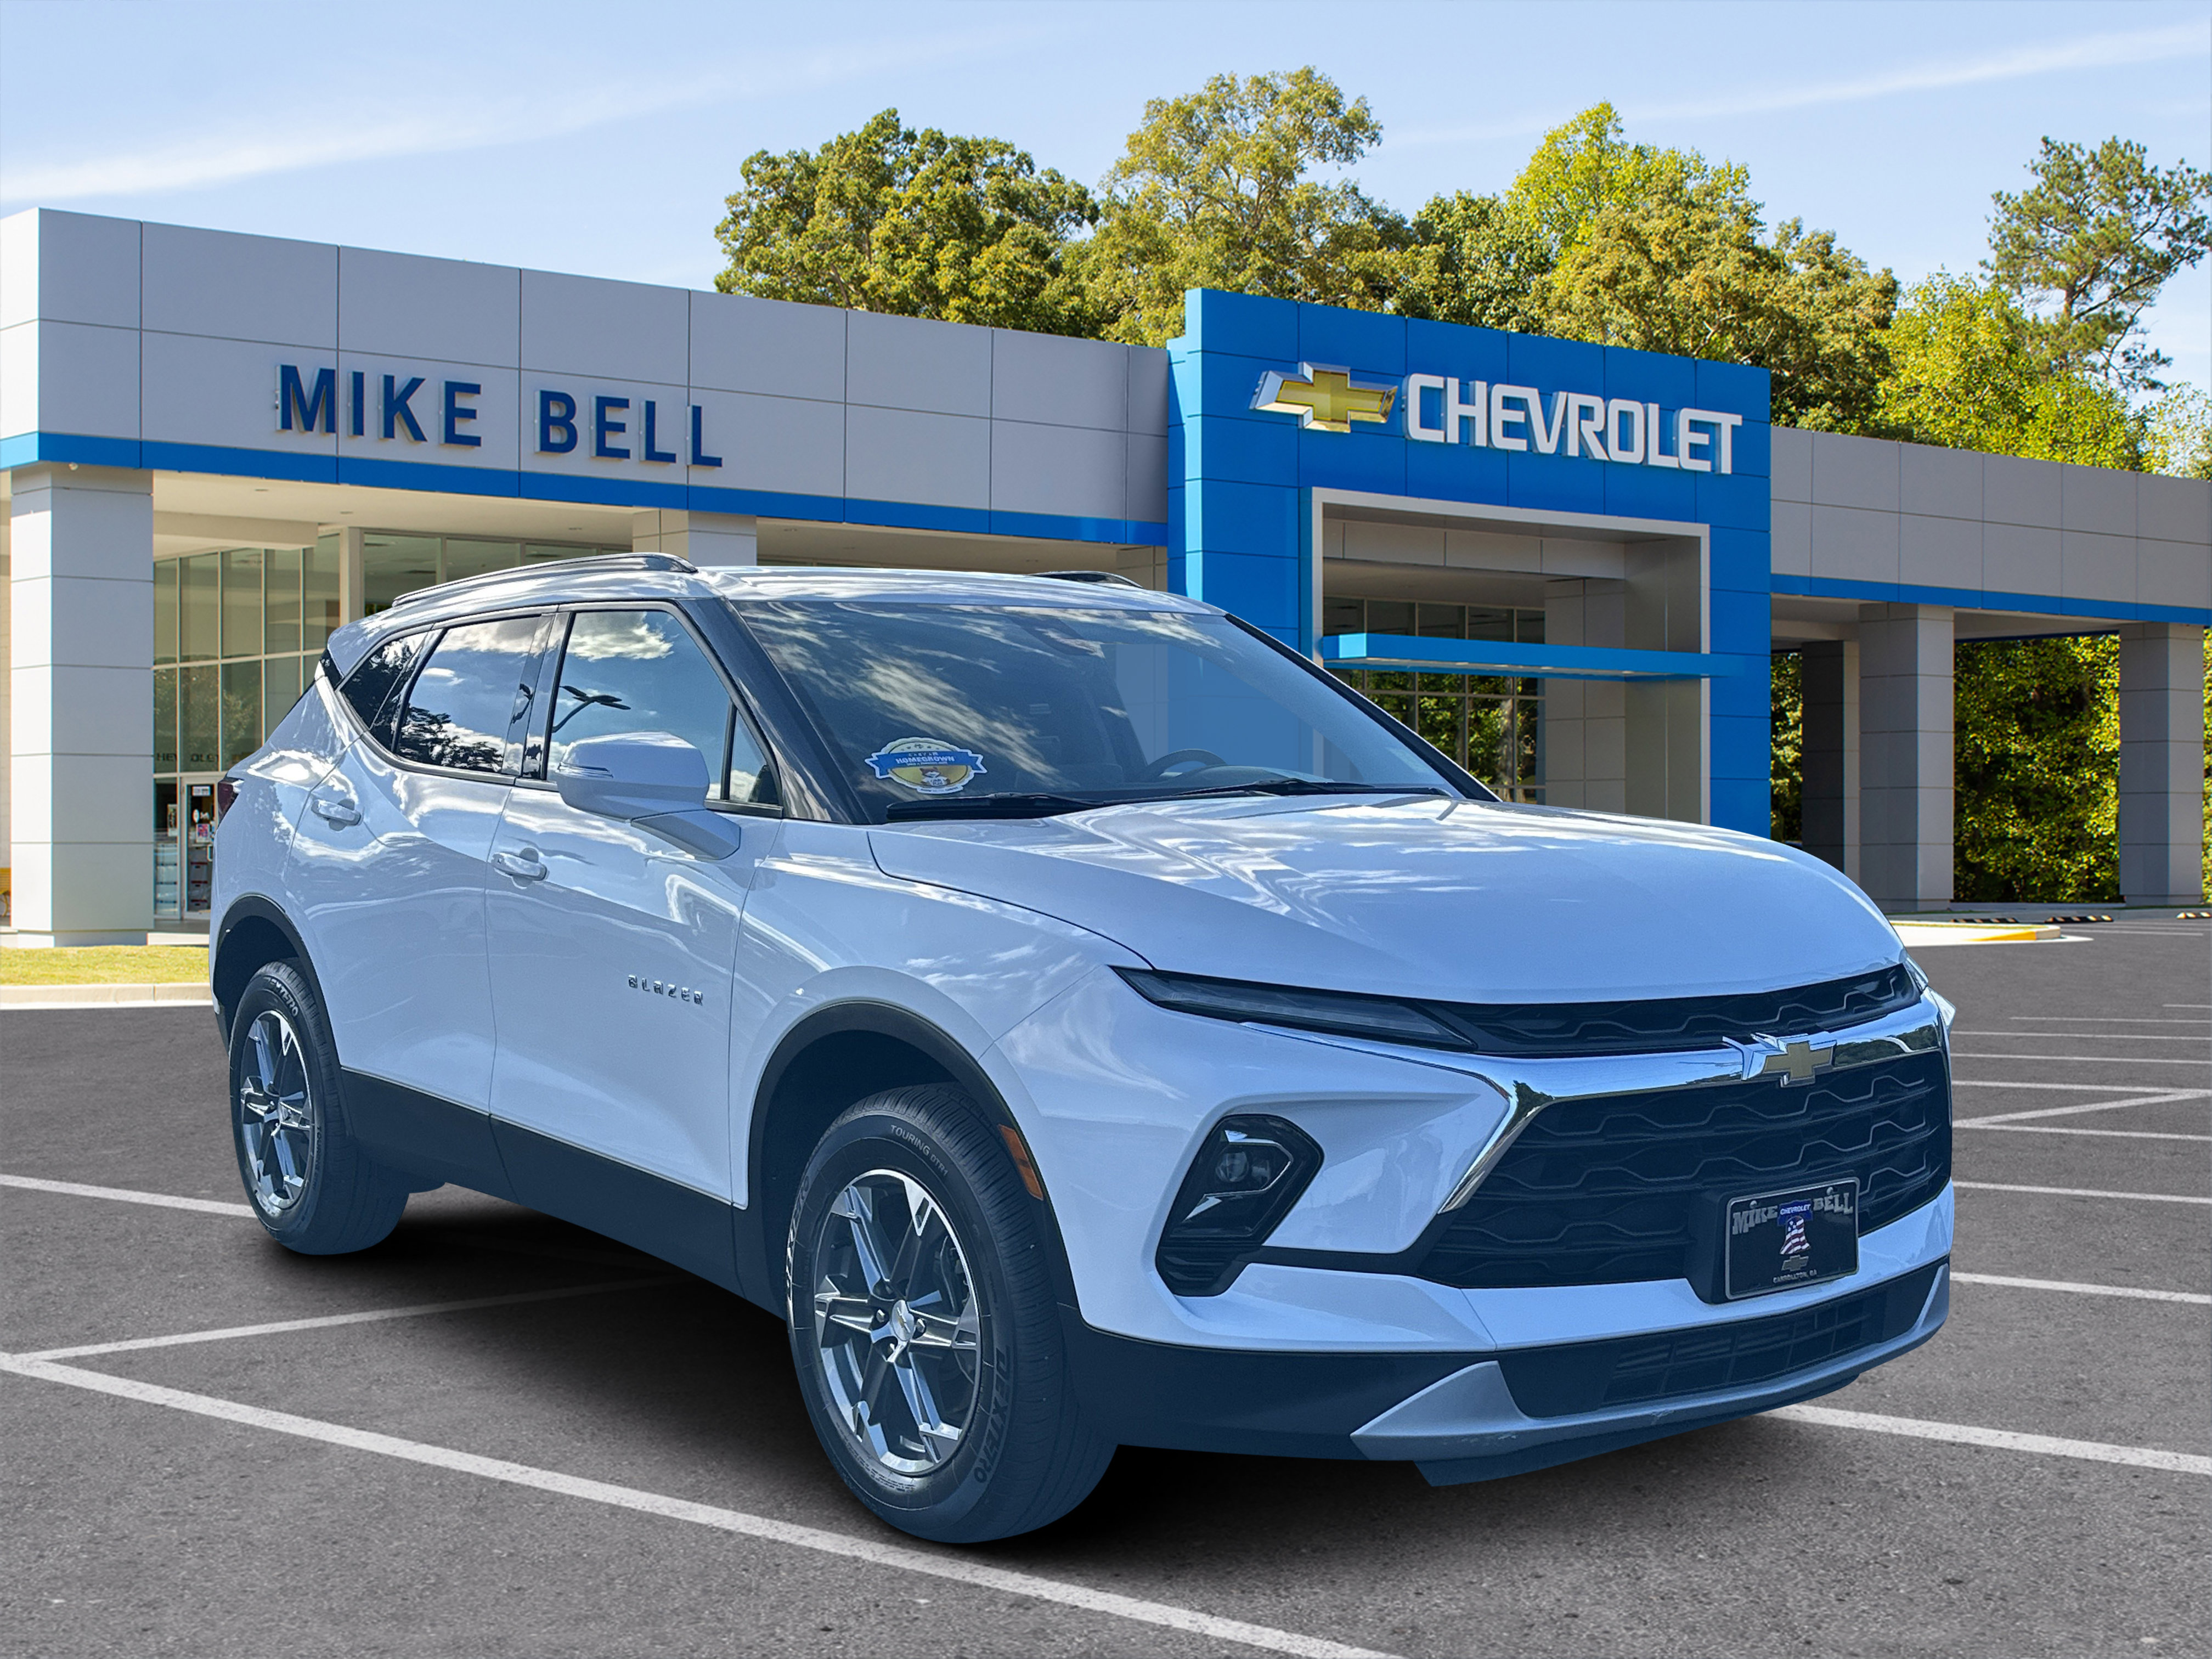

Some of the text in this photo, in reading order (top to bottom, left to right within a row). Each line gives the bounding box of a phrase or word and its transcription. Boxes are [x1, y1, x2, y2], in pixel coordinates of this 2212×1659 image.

[276, 364, 723, 467] MIKE BELL
[1403, 373, 1743, 475] CHEVROLET
[895, 755, 955, 764] HOMEGROWN
[628, 974, 703, 1006] BLAZER
[890, 1125, 931, 1156] TOURING
[1732, 1192, 1853, 1235] MIKE CHEVROLET BELL
